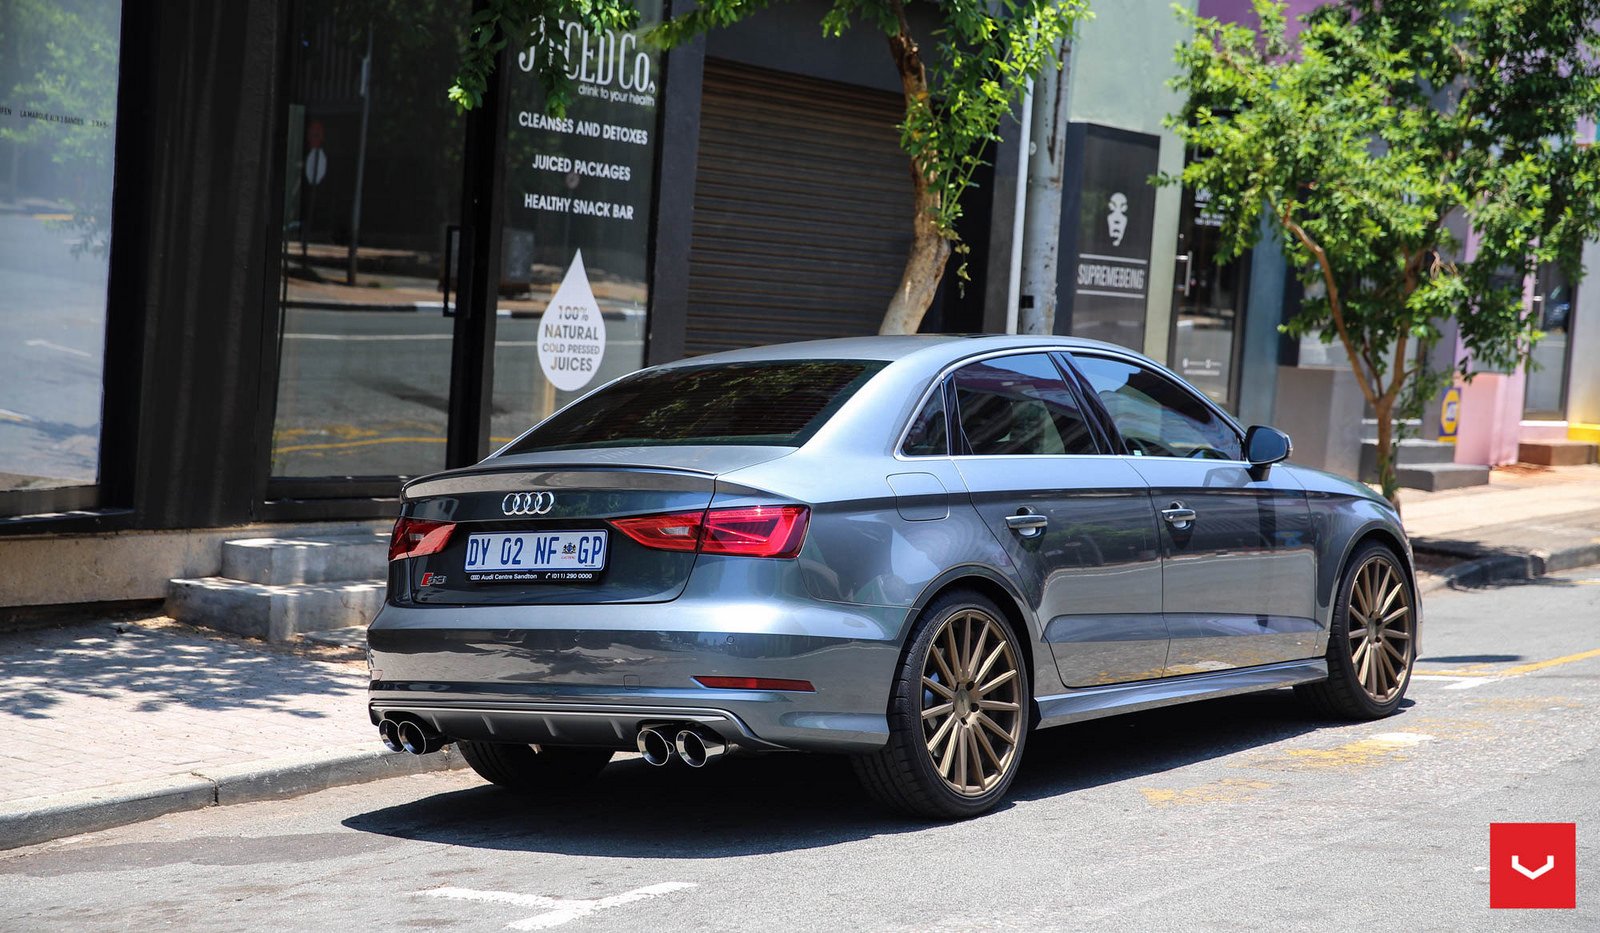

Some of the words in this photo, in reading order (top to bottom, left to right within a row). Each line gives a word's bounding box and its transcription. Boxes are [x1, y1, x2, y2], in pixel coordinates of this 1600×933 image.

[578, 82, 599, 97] drink
[600, 87, 609, 99] to
[610, 91, 628, 102] your
[629, 92, 655, 107] health
[519, 111, 574, 133] CLEANSES
[576, 120, 600, 138] AND
[602, 124, 648, 146] DETOXES
[532, 154, 571, 173] JUICED
[574, 159, 631, 181] PACKAGES
[524, 193, 571, 213] HEALTHY
[573, 199, 611, 218] SNACK
[613, 204, 634, 220] BAR
[1077, 263, 1145, 290] SUPREMEBEING
[558, 305, 589, 322] 100%
[544, 323, 599, 340] NATURAL
[542, 343, 565, 353] COLD
[567, 345, 600, 355] PRESSED
[551, 356, 593, 372] JUICES
[467, 538, 491, 566] DY
[500, 537, 524, 566] 02
[534, 536, 560, 565] NF
[578, 536, 603, 565] GP
